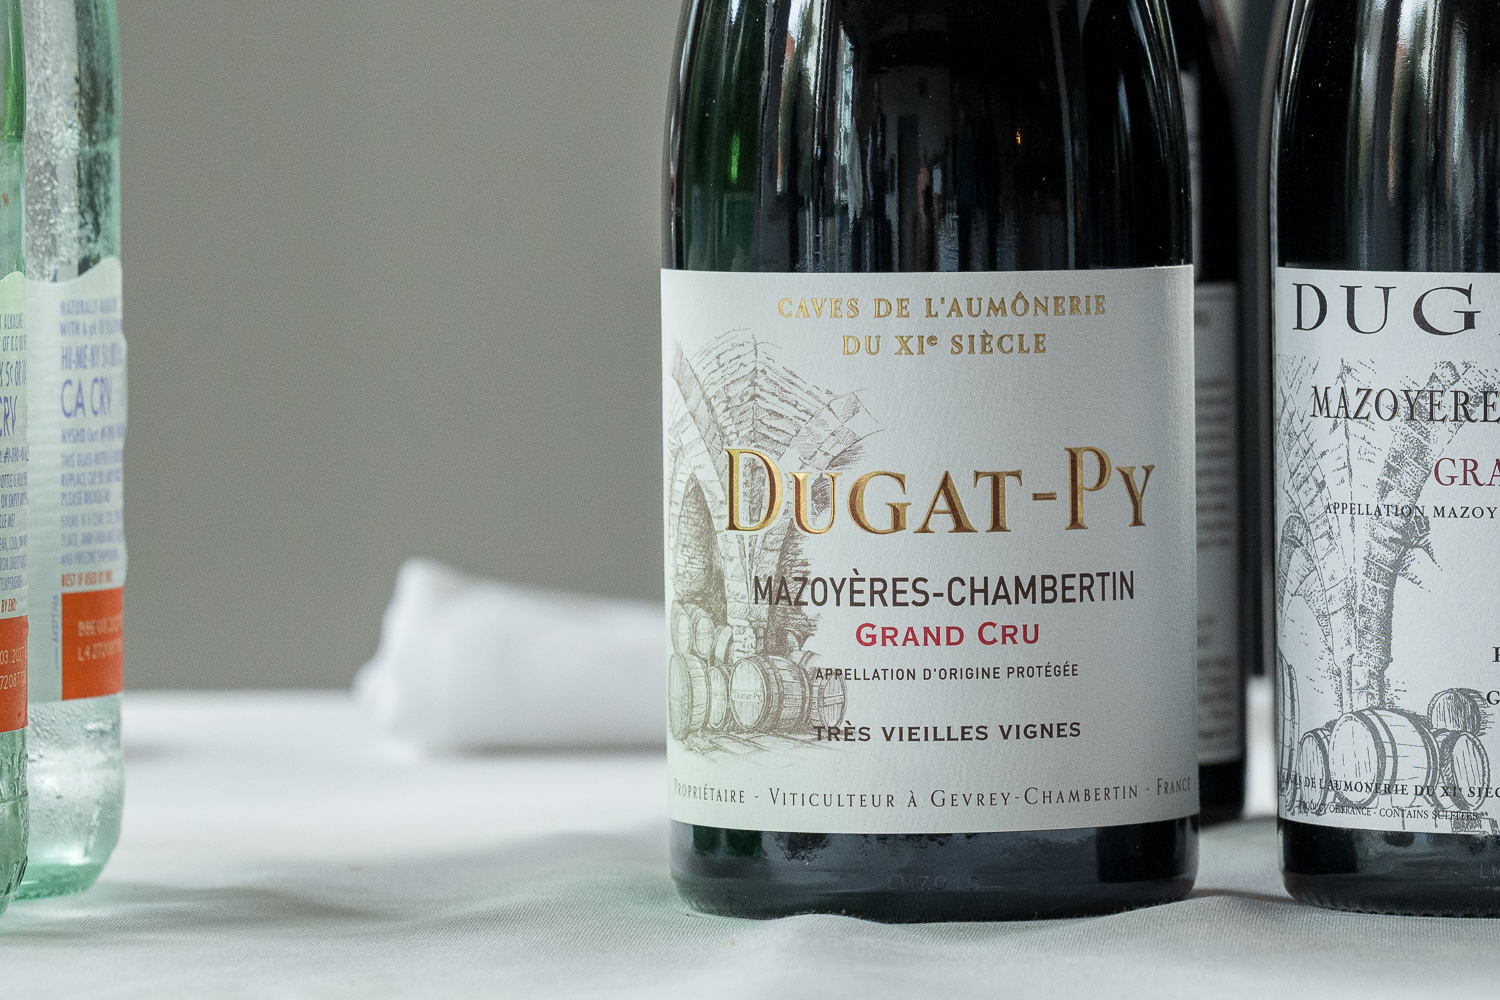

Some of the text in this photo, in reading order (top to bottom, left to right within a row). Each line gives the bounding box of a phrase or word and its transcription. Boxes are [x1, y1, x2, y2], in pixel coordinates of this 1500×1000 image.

[777, 291, 1106, 319] CAVES DE L'AUMÔNERIE
[842, 335, 881, 356] DU
[950, 330, 1047, 355] SIÈCLE
[60, 379, 86, 418] CA
[1325, 501, 1426, 518] APPELLATION
[753, 567, 1135, 608] MAZOYÈRES-CHAMBERTIN
[815, 661, 1079, 681] APPELLATION D'ORIGINE PROTÉGÉE
[813, 721, 1081, 742] TRÈS VIEILLES VIGNES
[1379, 808, 1429, 820] CONTAINS
